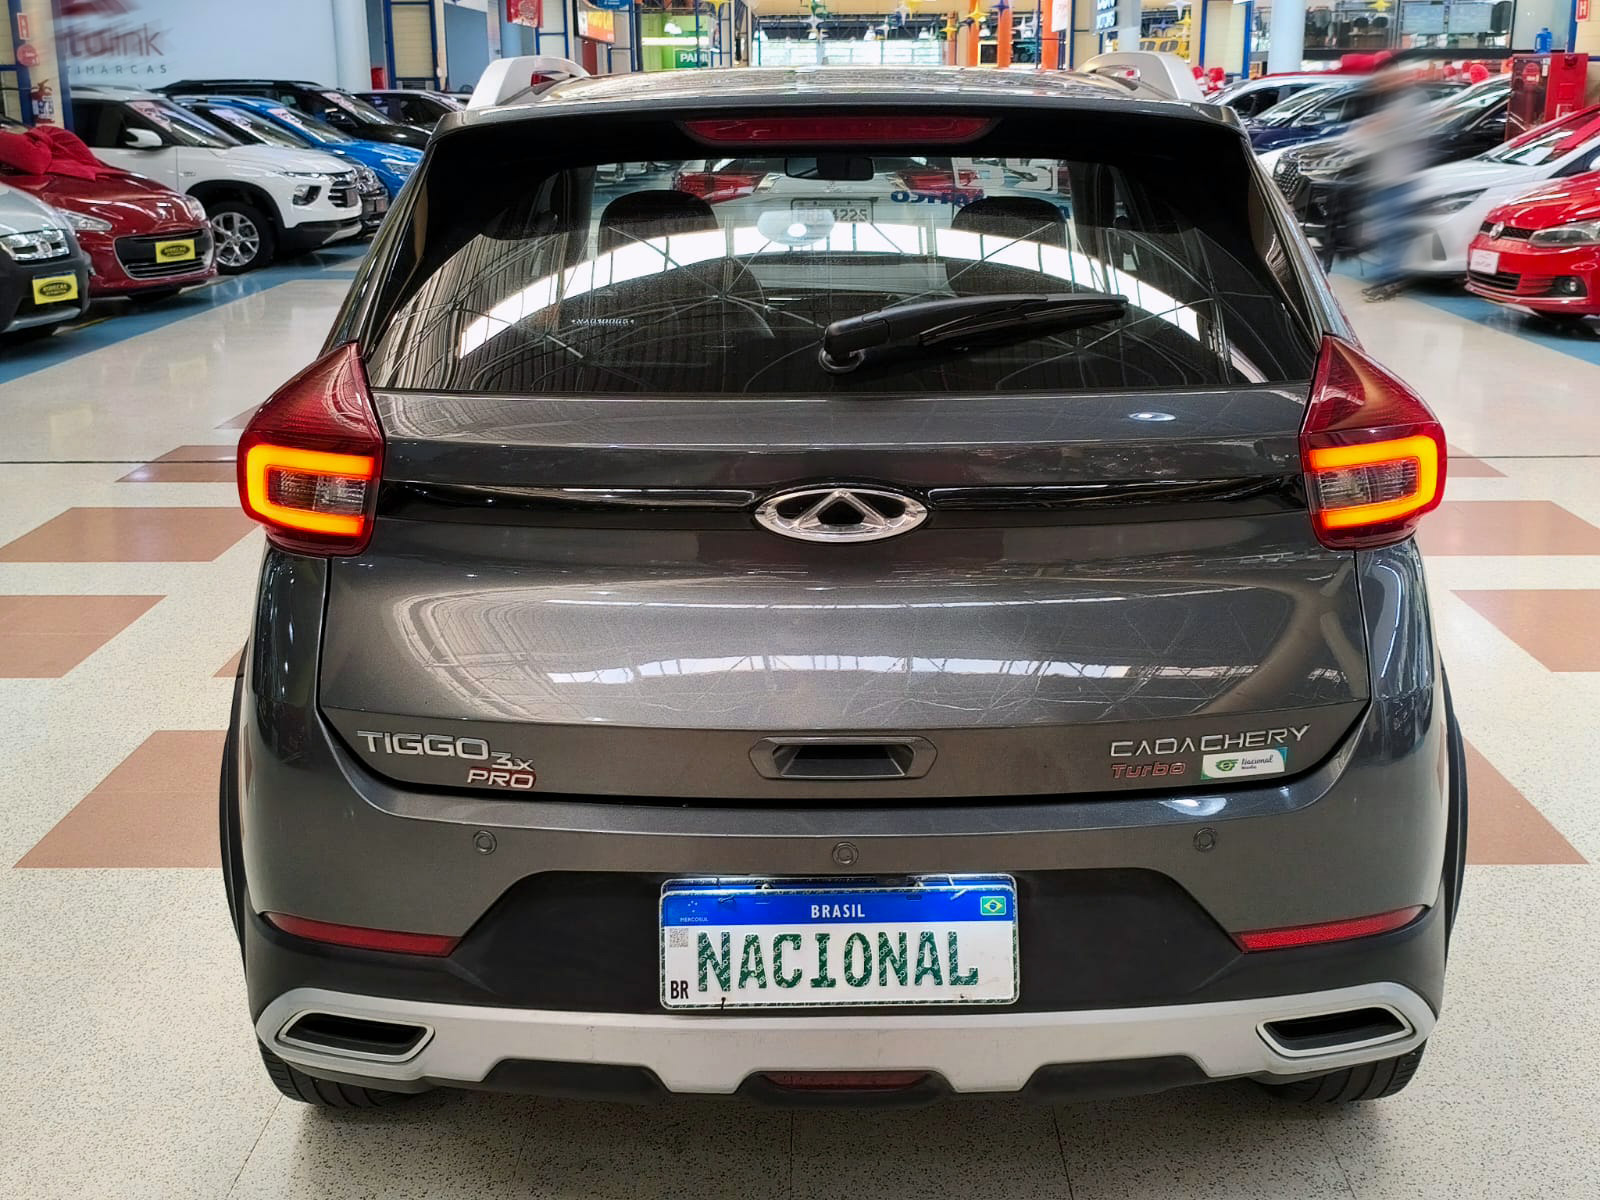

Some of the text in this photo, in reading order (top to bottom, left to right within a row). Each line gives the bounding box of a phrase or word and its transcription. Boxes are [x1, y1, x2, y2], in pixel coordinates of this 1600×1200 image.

[357, 731, 489, 760] TIGGO
[467, 769, 535, 789] PRO
[1111, 762, 1186, 779] Turbo
[810, 903, 865, 919] BRASIL
[697, 931, 979, 992] NACIONAL
[670, 980, 689, 1000] BR
